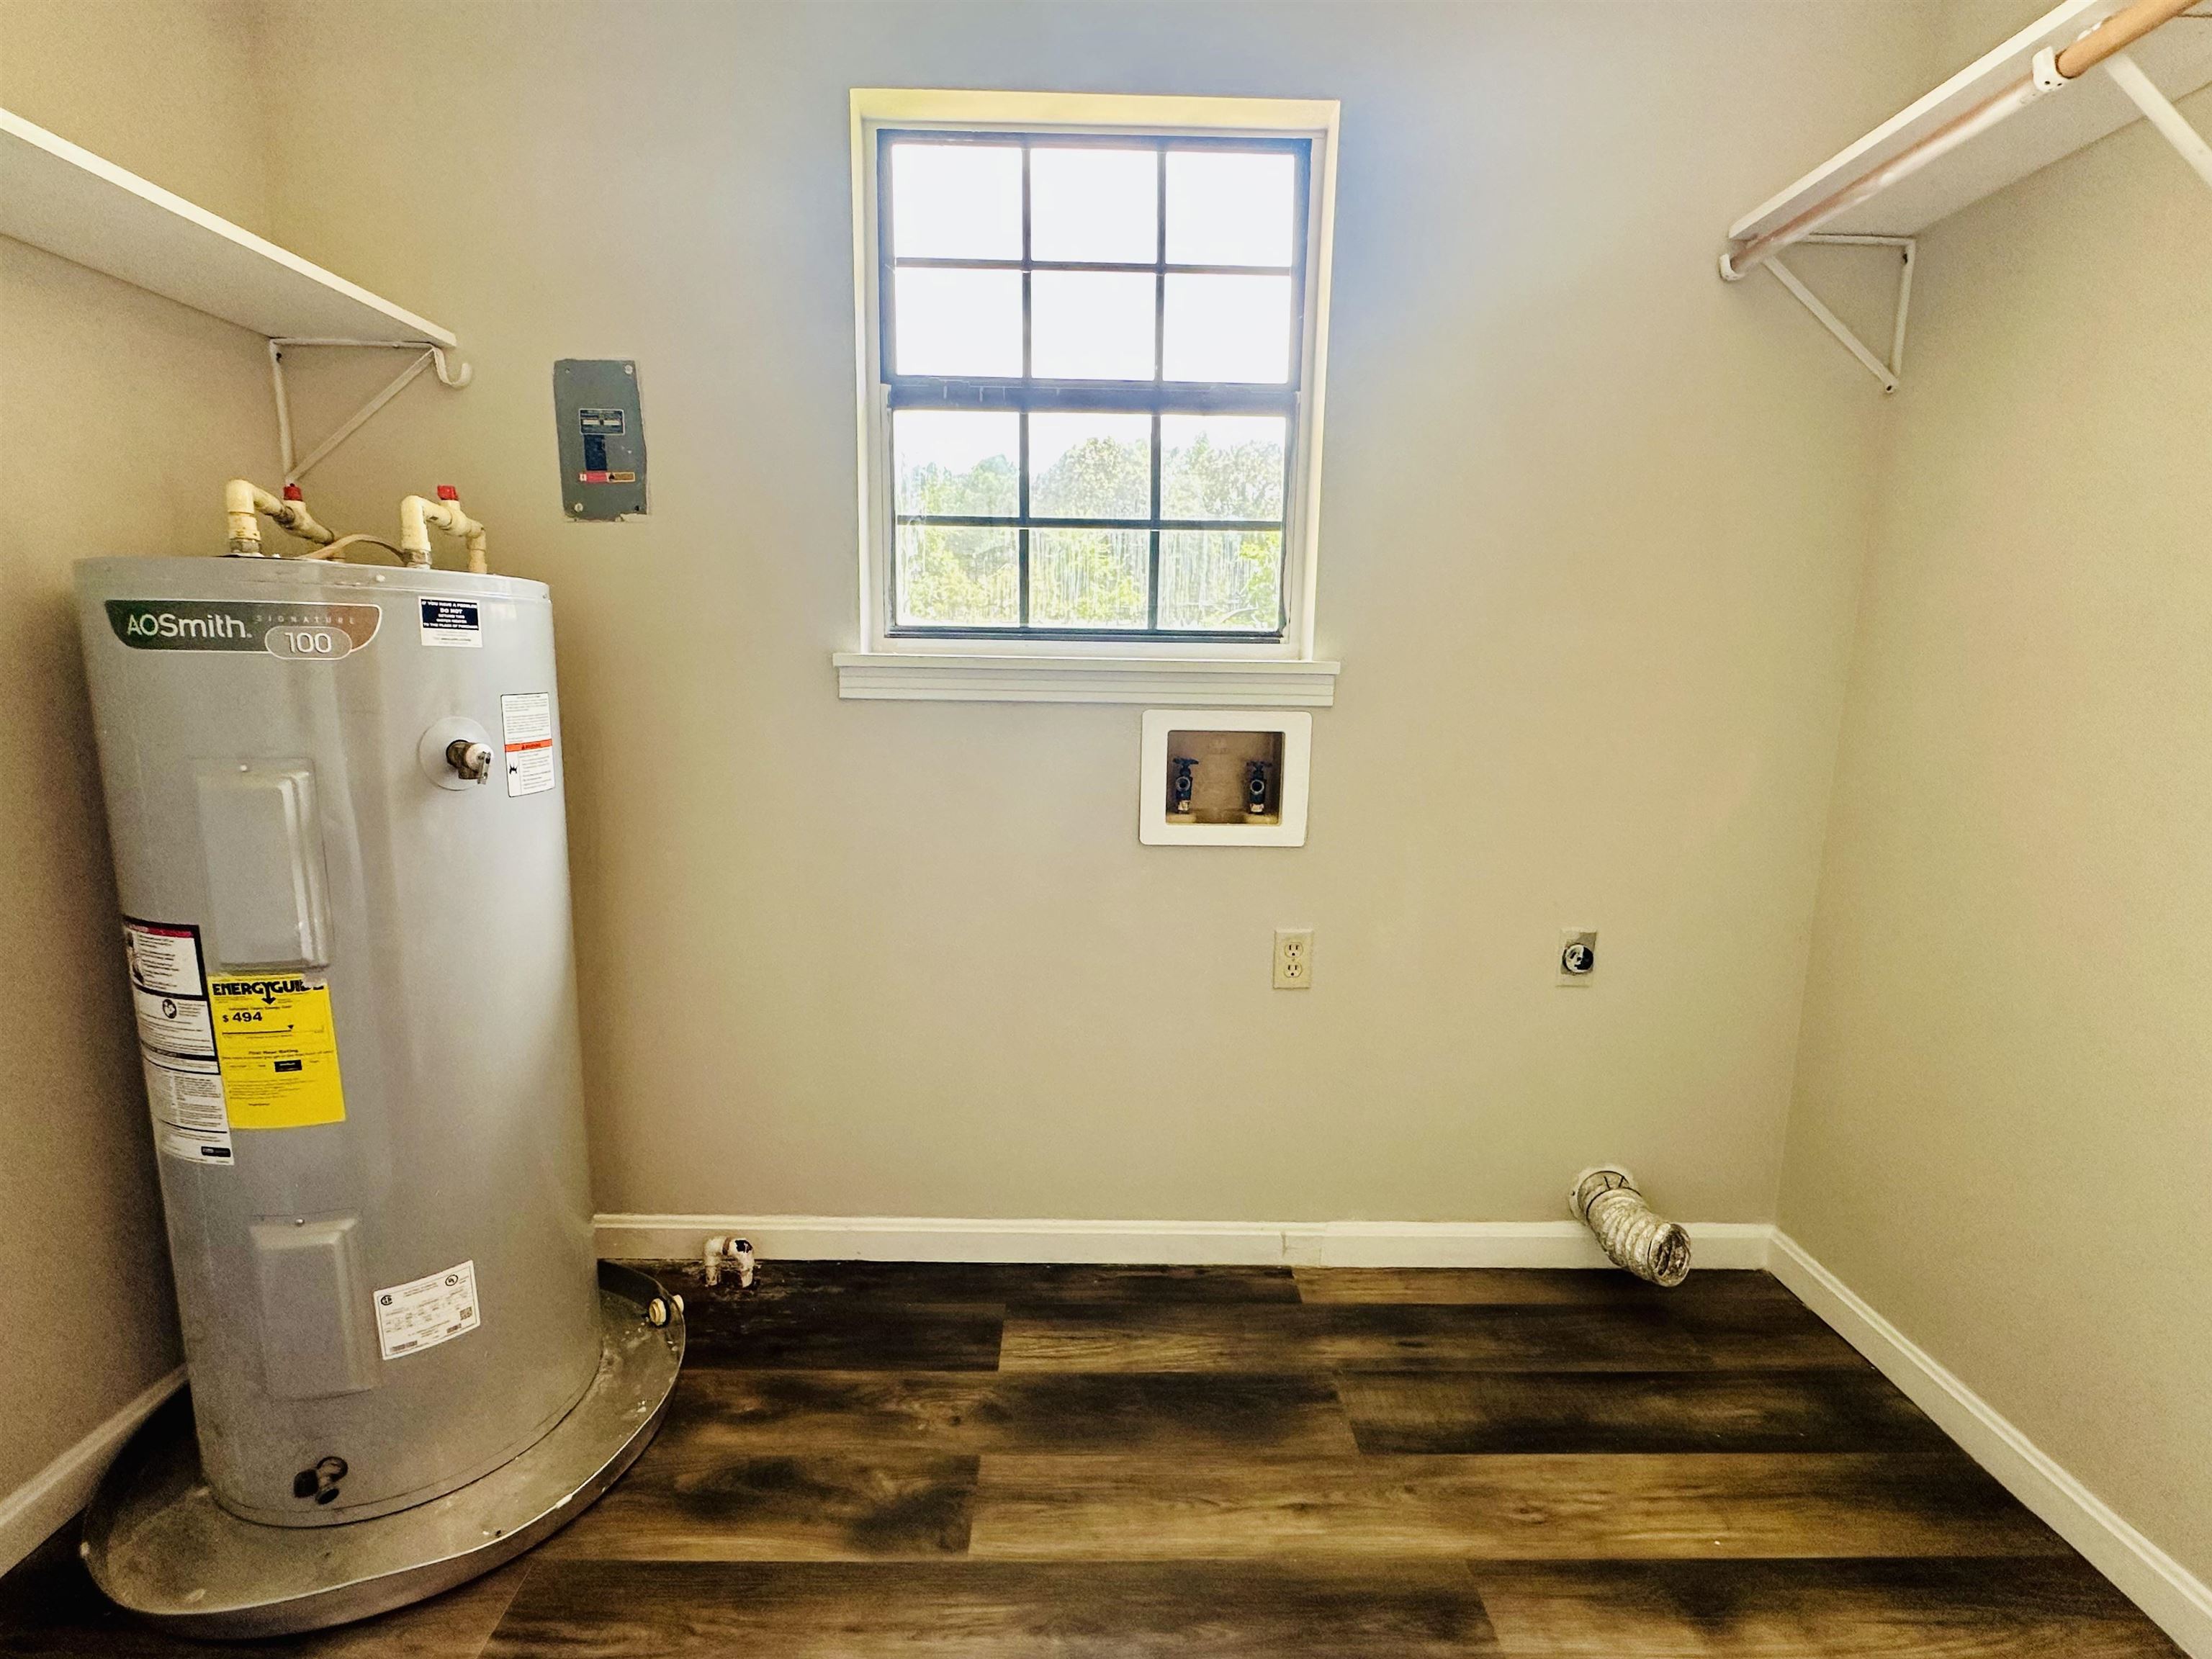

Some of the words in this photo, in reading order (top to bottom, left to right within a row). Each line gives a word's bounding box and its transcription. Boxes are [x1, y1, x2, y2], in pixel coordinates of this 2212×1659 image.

[256, 615, 355, 624] SIGNATURE
[284, 632, 332, 653] 100
[212, 979, 324, 998] ENERGYGUI
[232, 1011, 263, 1022] 494
